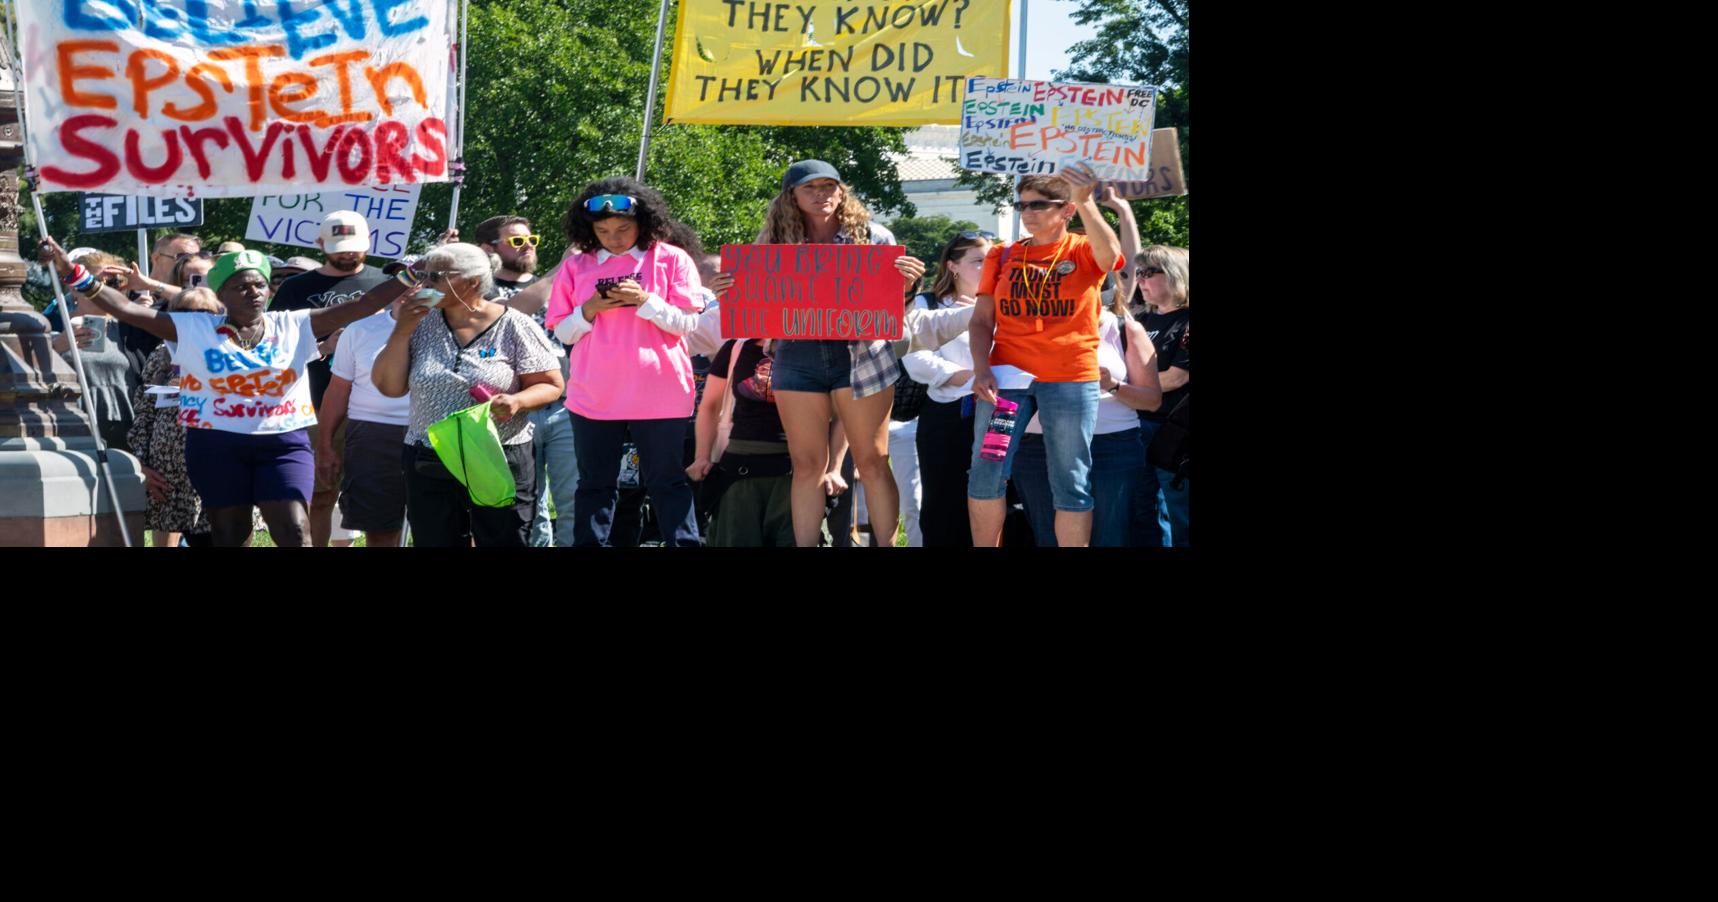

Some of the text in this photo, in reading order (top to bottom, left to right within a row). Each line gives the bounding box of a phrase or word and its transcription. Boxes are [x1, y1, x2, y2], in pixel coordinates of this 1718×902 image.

[722, 0, 971, 35] THEY KNOW?
[755, 41, 934, 76] WHEN DID
[695, 74, 985, 104] THEY KNOW IT
[1127, 88, 1153, 99] FREE
[1130, 99, 1150, 107] DC
[103, 194, 196, 228] FILES
[345, 193, 409, 220] THE
[257, 214, 407, 256] VICS
[724, 246, 881, 275] YOU BRING
[834, 277, 864, 306] TO
[1011, 282, 1061, 299] MUST
[1000, 299, 1075, 316] GO NOW!
[727, 307, 897, 338] THE UNIFORM
